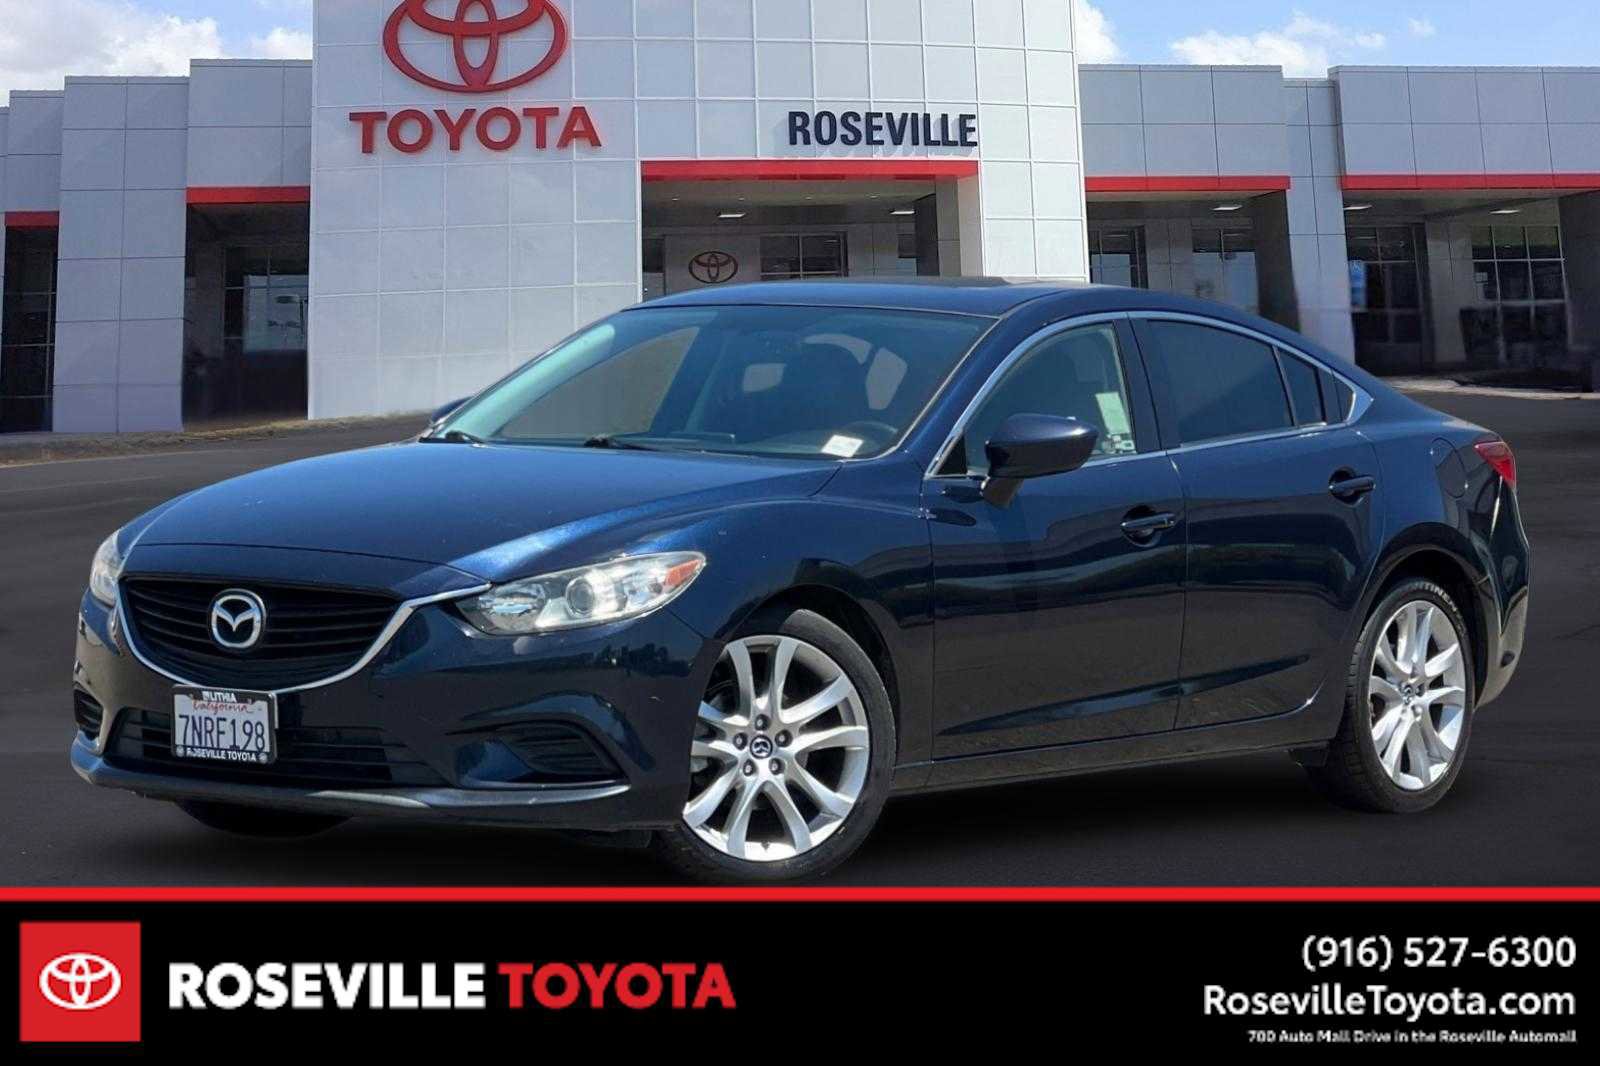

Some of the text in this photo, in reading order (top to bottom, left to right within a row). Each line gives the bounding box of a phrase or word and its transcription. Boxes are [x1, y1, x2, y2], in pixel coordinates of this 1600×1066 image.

[349, 106, 602, 154] TOYOTA
[788, 110, 978, 147] ROSEVILLE
[179, 714, 265, 753] 7NRF198
[186, 747, 257, 762] ROSEVILLE TOYOTA
